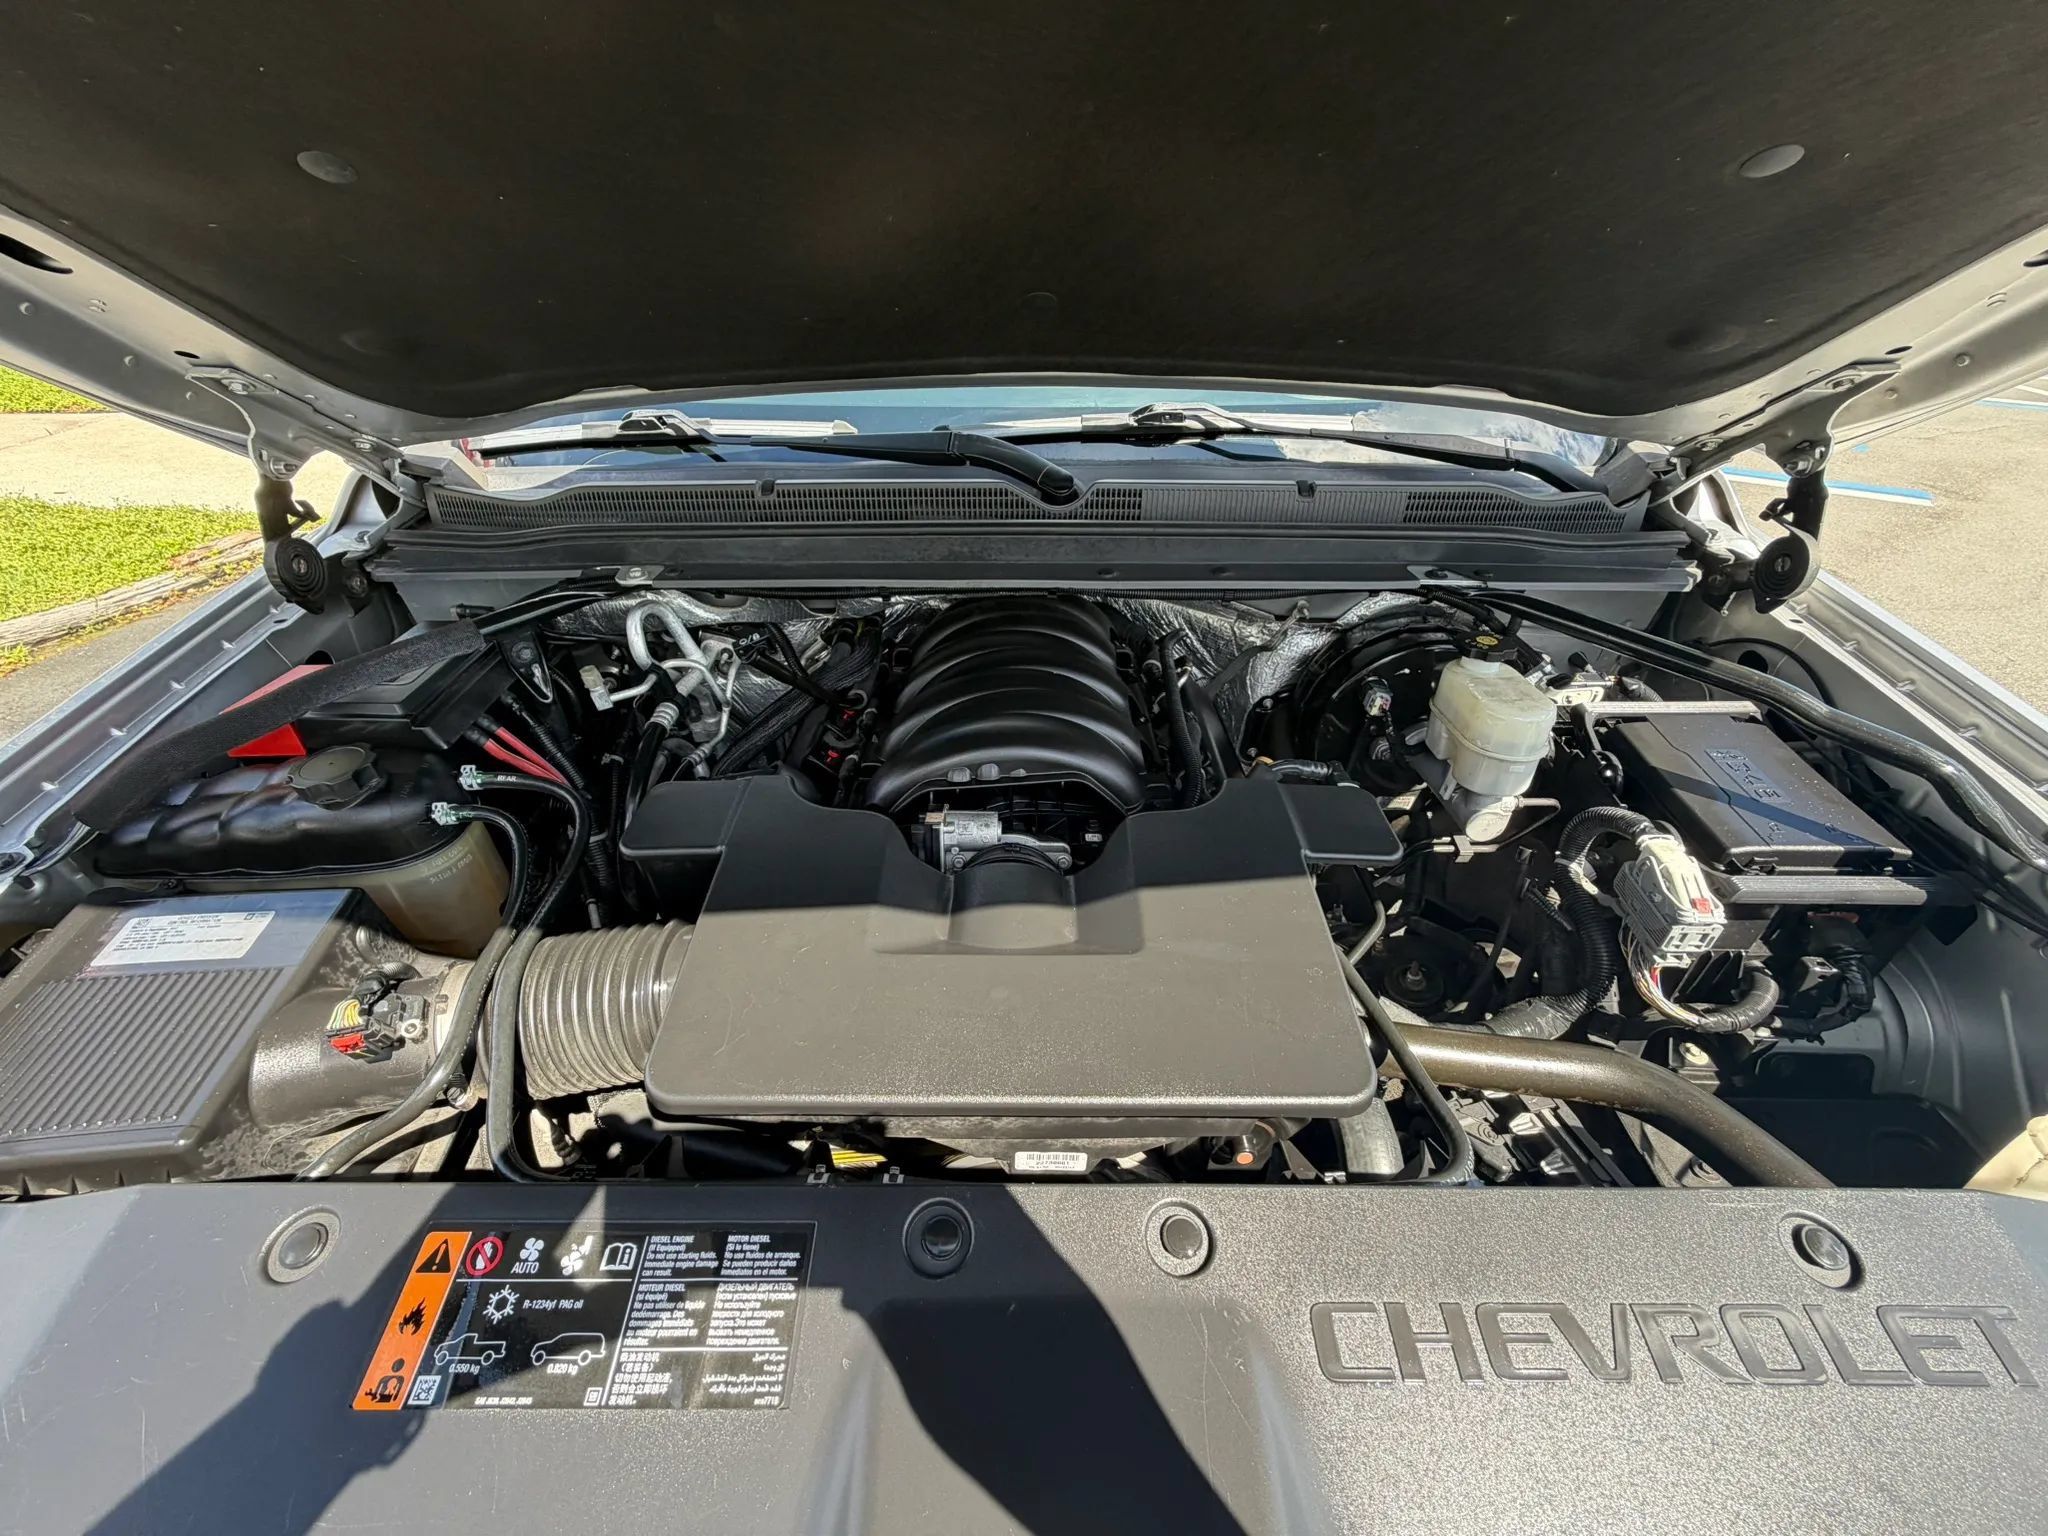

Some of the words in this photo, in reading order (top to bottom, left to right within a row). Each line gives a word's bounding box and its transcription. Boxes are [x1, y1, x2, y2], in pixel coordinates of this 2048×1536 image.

[651, 1235, 671, 1243] DIESEL
[672, 1235, 695, 1243] ENGINE
[728, 1235, 749, 1243] MOTOR
[750, 1235, 770, 1243] DIESEL
[511, 1262, 540, 1274] AUTO
[675, 1260, 695, 1269] engine
[695, 1260, 719, 1268] damage
[732, 1260, 753, 1268] pueden
[754, 1260, 778, 1268] producir
[523, 1300, 557, 1311] R-1234yf
[558, 1300, 573, 1309] PAG
[1310, 1300, 2041, 1387] CHEVROLET
[470, 1364, 480, 1375] kg
[567, 1364, 579, 1375] kg
